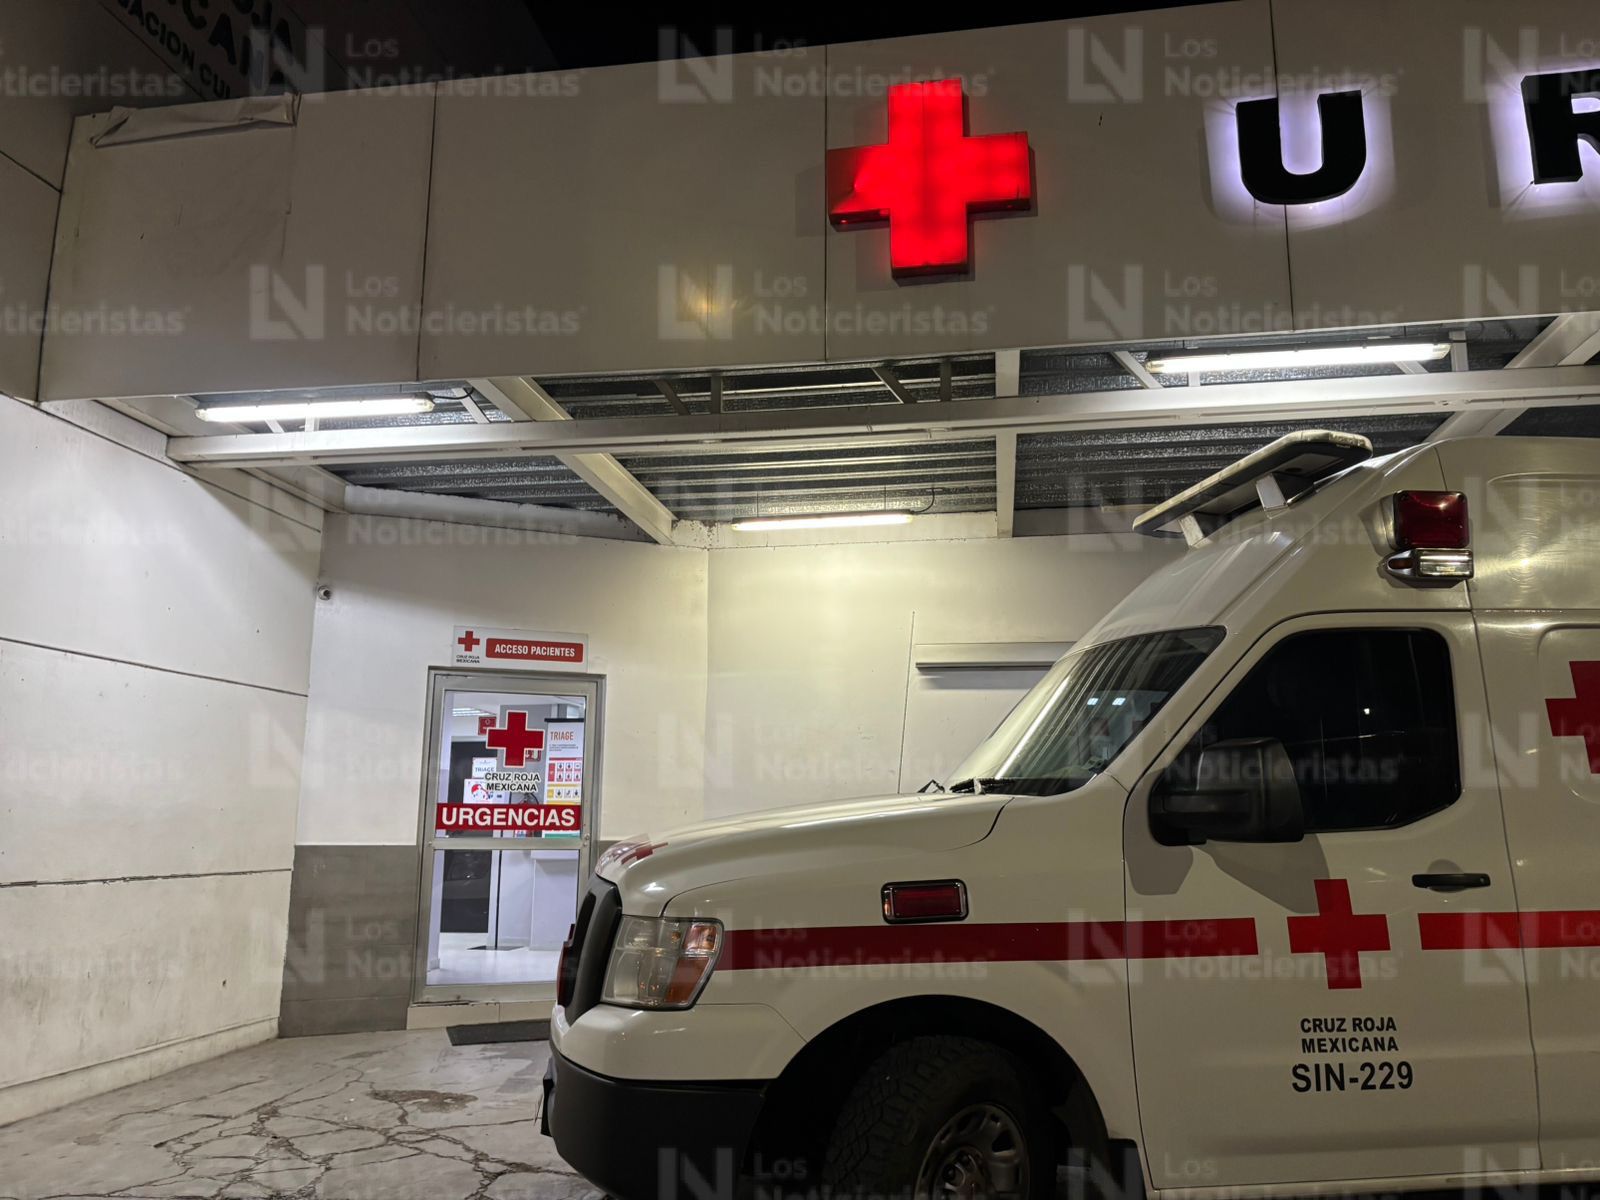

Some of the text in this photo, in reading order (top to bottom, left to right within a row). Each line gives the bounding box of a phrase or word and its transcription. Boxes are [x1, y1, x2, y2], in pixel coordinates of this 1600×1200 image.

[495, 644, 575, 657] ACCESO PACIENTES
[550, 731, 574, 741] TRIAGE
[485, 773, 540, 782] CRUZ ROJA
[486, 783, 537, 791] MEXICANA
[442, 807, 575, 827] URGENCIAS
[1300, 1017, 1397, 1033] CRUZ ROJA
[1301, 1037, 1399, 1053] MEXICANA
[1292, 1061, 1413, 1093] SIN-229
